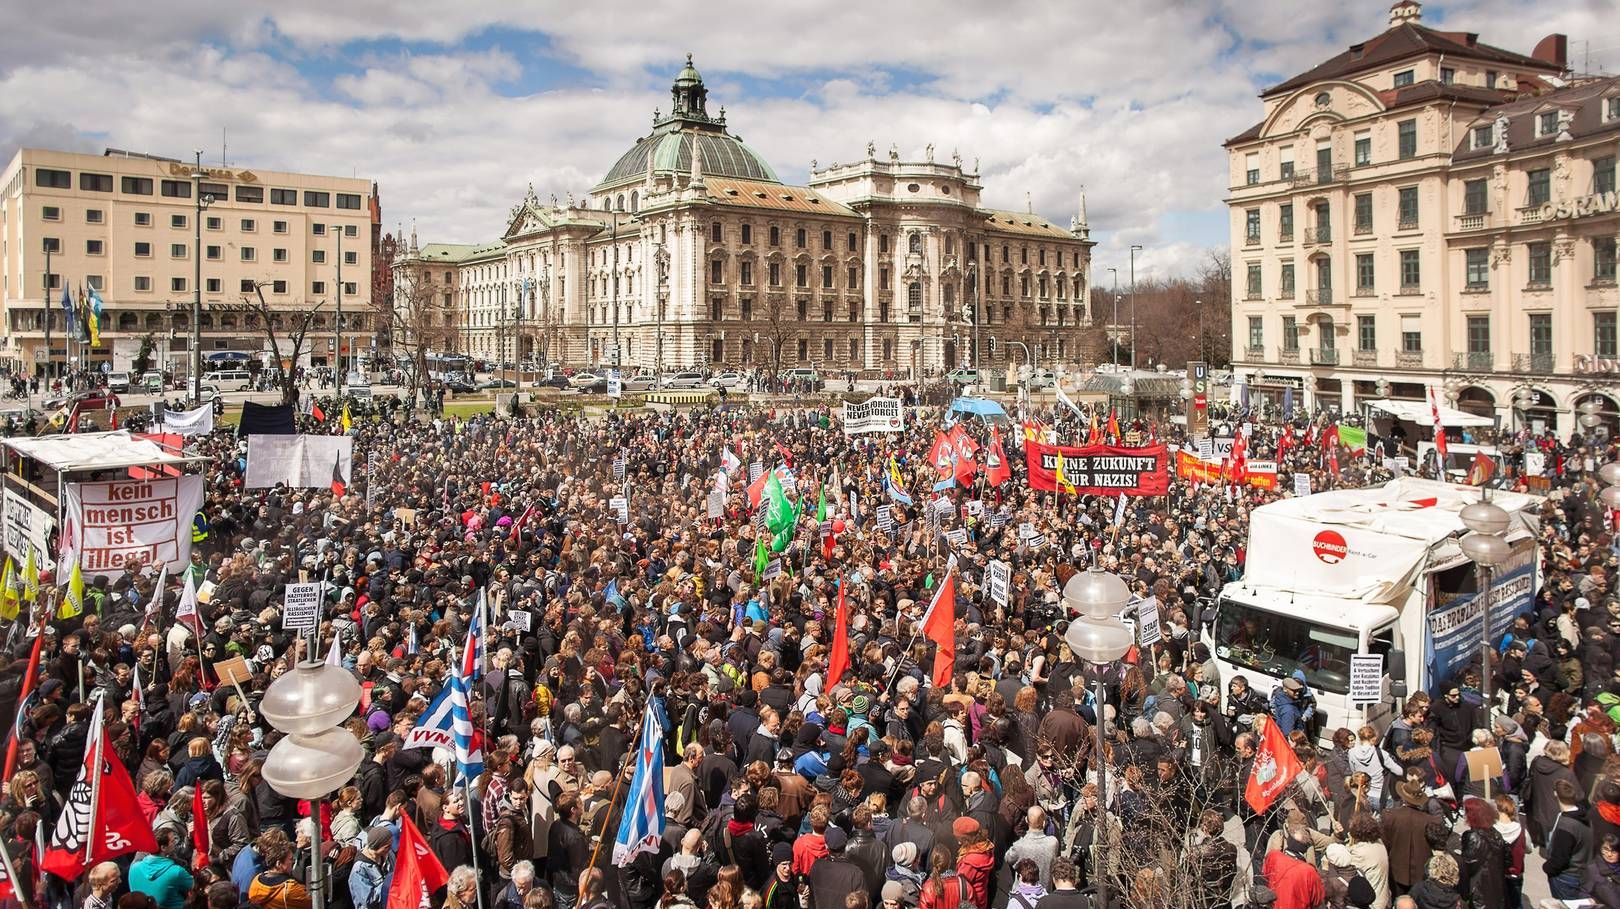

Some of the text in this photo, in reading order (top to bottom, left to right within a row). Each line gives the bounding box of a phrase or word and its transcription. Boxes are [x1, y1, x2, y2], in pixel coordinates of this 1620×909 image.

[1196, 366, 1204, 378] U
[1196, 381, 1204, 393] S
[846, 403, 870, 412] NEVER
[846, 408, 898, 420] NEVER FORGET
[1093, 456, 1155, 471] ZUKUNFT
[1094, 474, 1137, 487] NAZIS!
[108, 483, 152, 500] kein
[86, 499, 172, 524] mensch
[106, 525, 135, 546] ist
[413, 730, 450, 744] VVN
